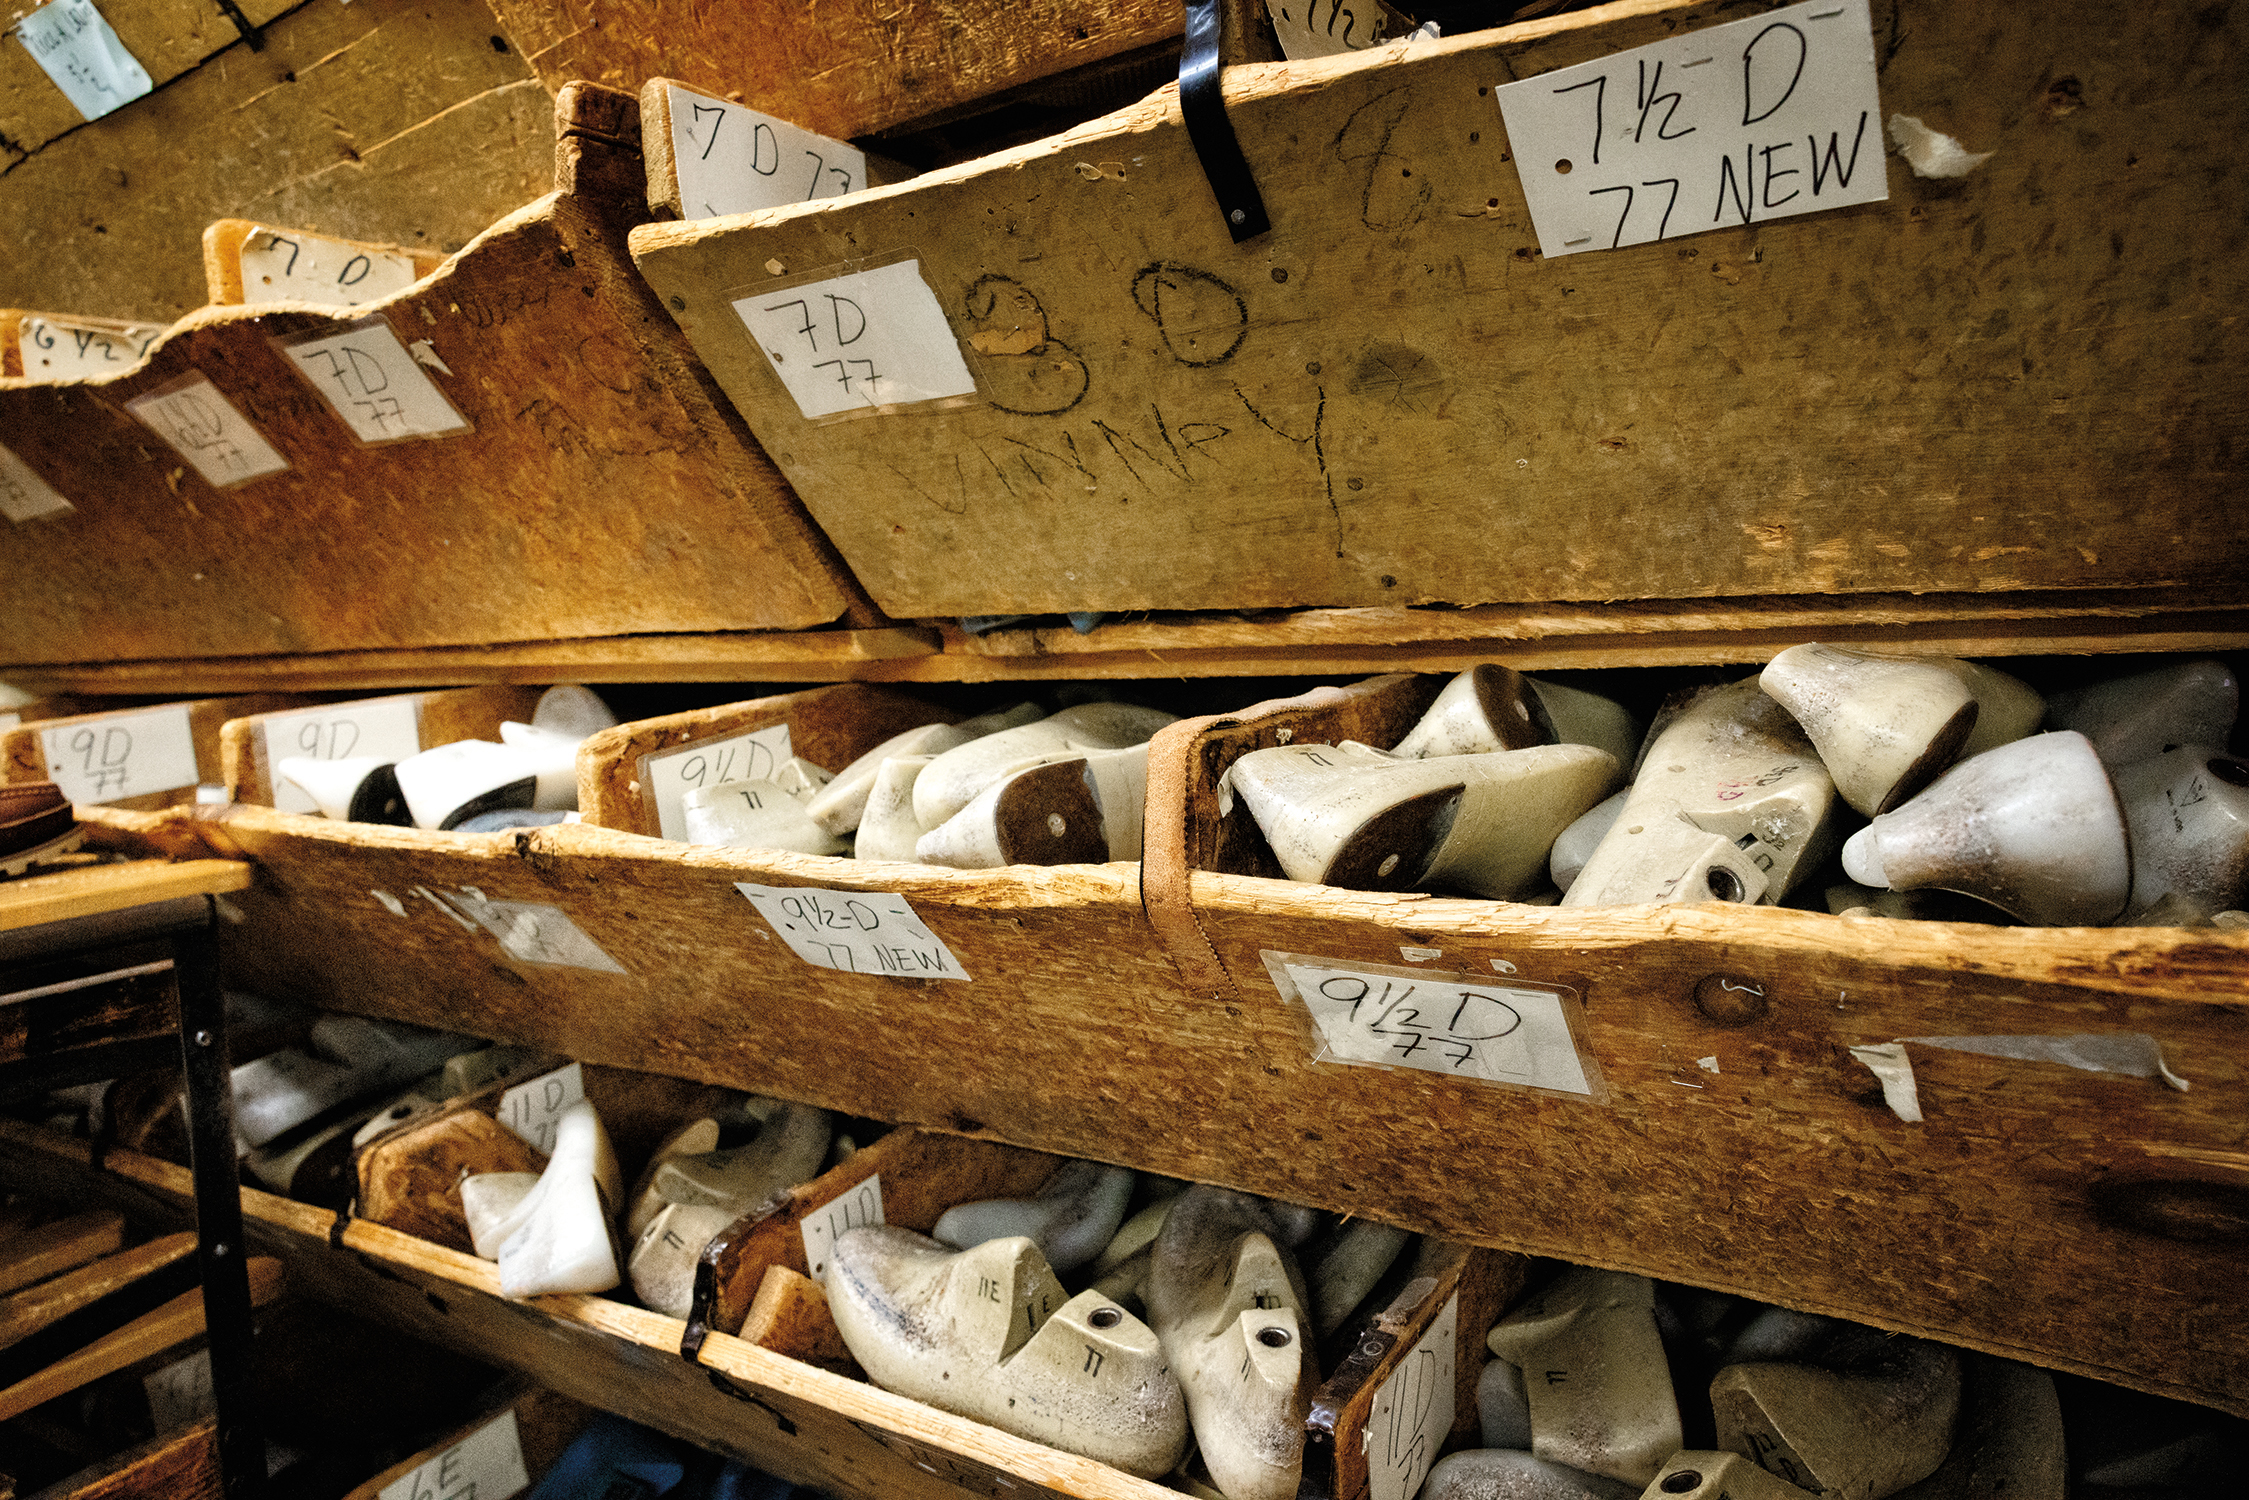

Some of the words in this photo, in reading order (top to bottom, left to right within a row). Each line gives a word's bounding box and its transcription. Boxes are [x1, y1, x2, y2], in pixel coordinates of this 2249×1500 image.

[1553, 75, 1607, 164] 7
[1742, 22, 1807, 126] D
[693, 103, 725, 160] 7
[750, 123, 778, 176] D
[1589, 178, 1680, 249] 77
[1713, 111, 1868, 224] NEW
[269, 237, 299, 276] 7
[812, 359, 883, 395] 77
[353, 397, 407, 433] 77
[806, 939, 856, 973] 77
[873, 943, 950, 972] NEW
[1448, 991, 1522, 1042] D
[1371, 1029, 1476, 1069] 77
